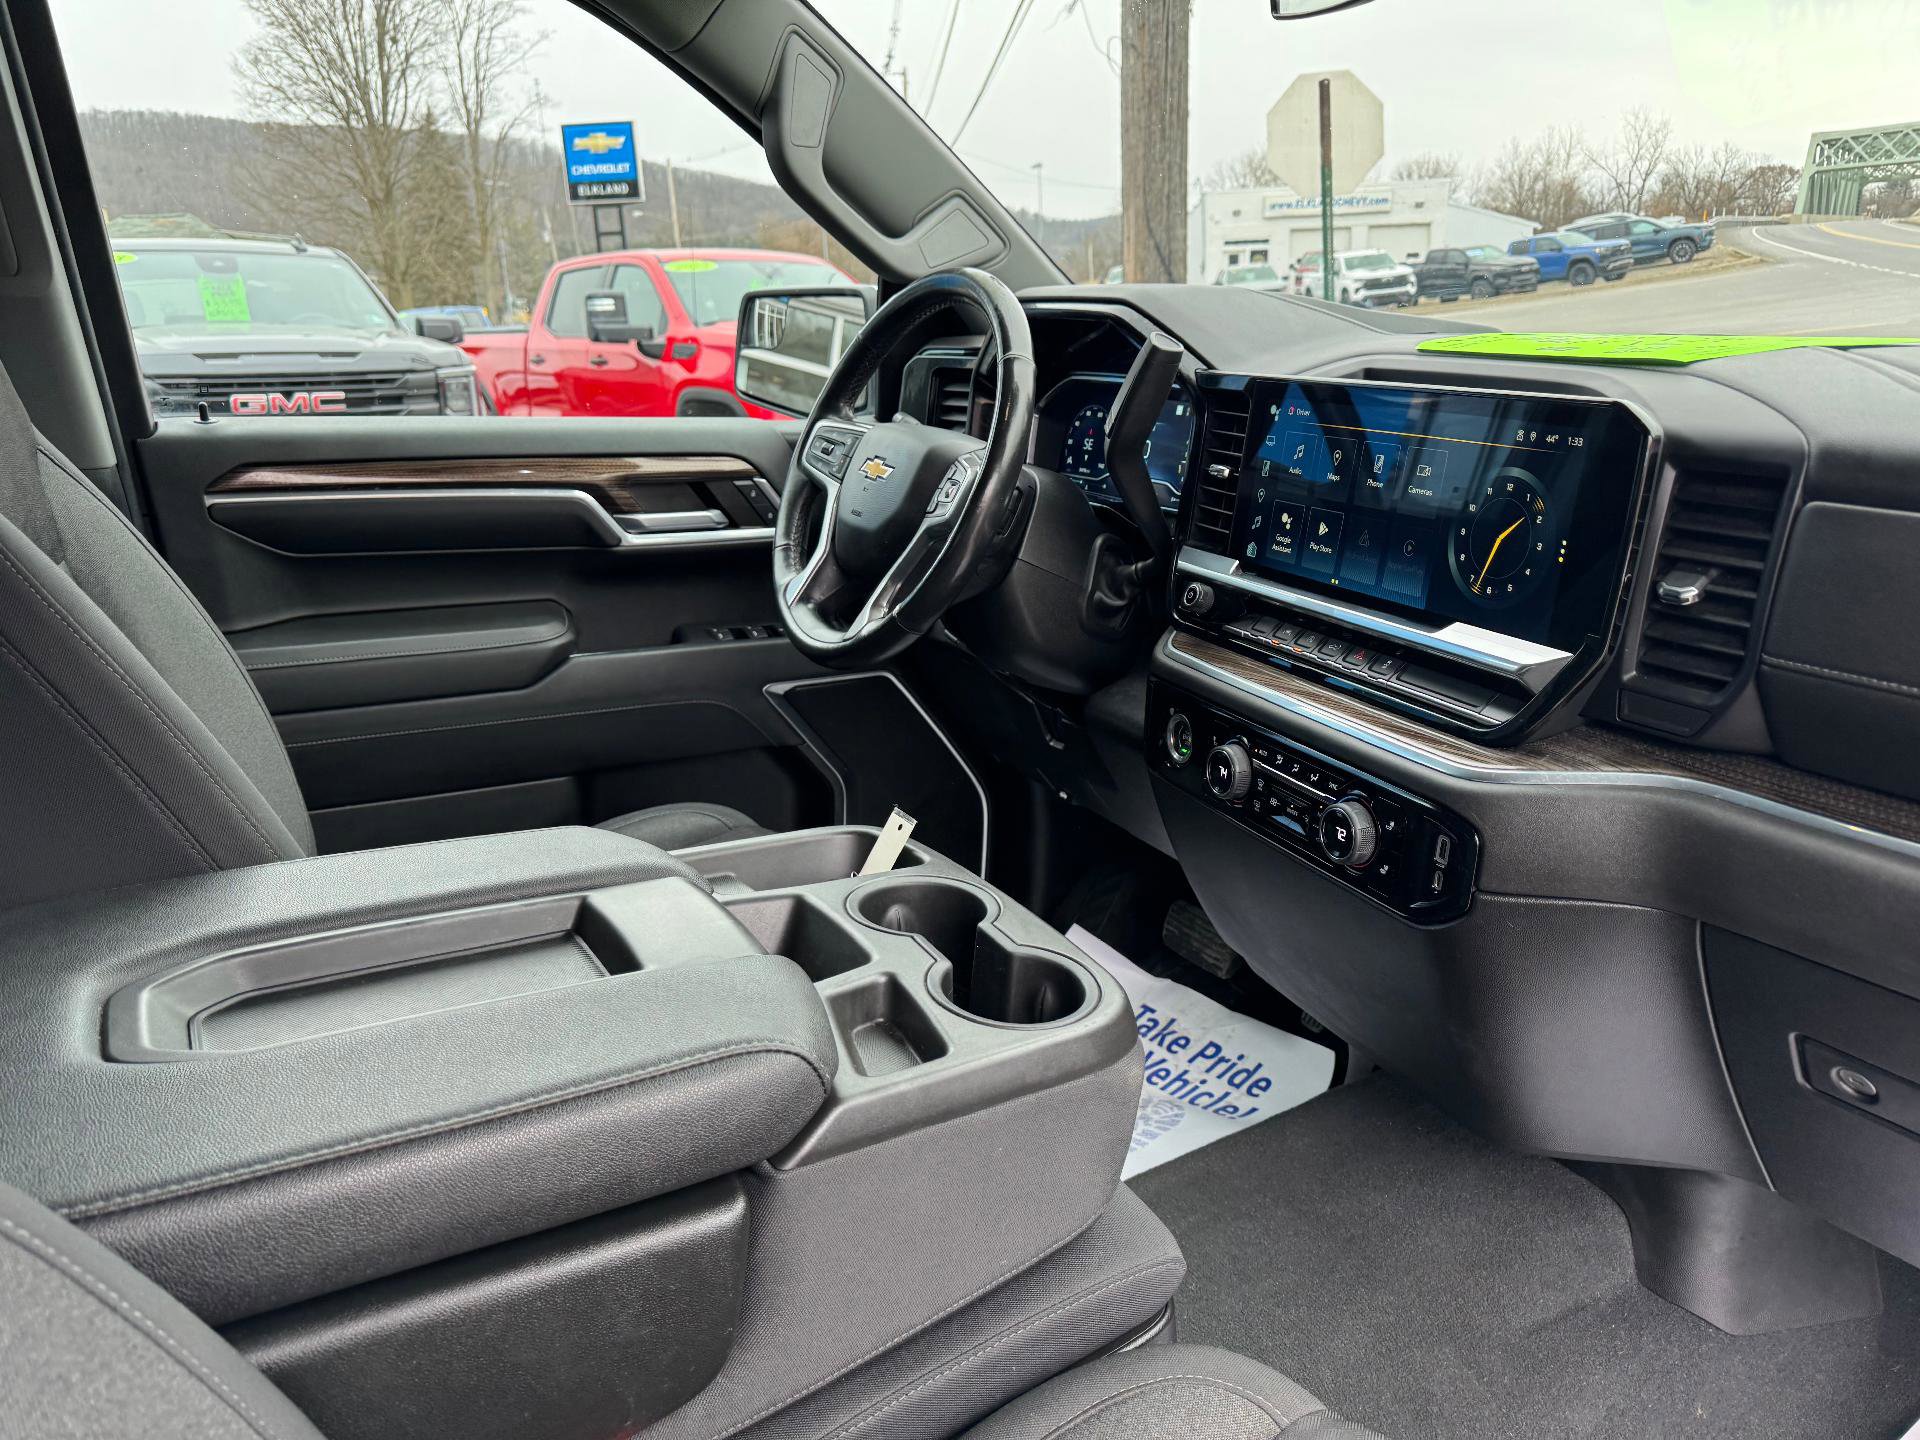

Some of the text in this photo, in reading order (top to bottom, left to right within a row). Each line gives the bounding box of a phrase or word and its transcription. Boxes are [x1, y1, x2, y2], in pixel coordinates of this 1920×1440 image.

[571, 162, 630, 176] CHEVROLET
[577, 182, 629, 197] ELKLAND
[230, 390, 347, 415] GMC
[1567, 436, 1584, 447] 1:33
[1326, 472, 1340, 481] Maps
[1366, 478, 1384, 488] Phone
[1506, 483, 1514, 492] 12
[1407, 484, 1433, 497] Cameras
[1469, 504, 1476, 512] 10
[1536, 516, 1543, 524] 2
[1460, 528, 1466, 536] 9
[1275, 533, 1292, 544] Google
[1271, 543, 1292, 554] Assistant
[1309, 541, 1332, 554] Play Store
[1536, 542, 1543, 551] 3
[1460, 553, 1466, 561] 8
[1525, 568, 1531, 576] 4
[1469, 574, 1475, 583] 7
[1486, 586, 1492, 595] 6
[1507, 584, 1513, 592] 5
[1218, 765, 1228, 779] 74
[1335, 825, 1347, 842] 72
[1136, 1003, 1273, 1098] Take Pride
[1144, 1050, 1259, 1120] Vehicle!
